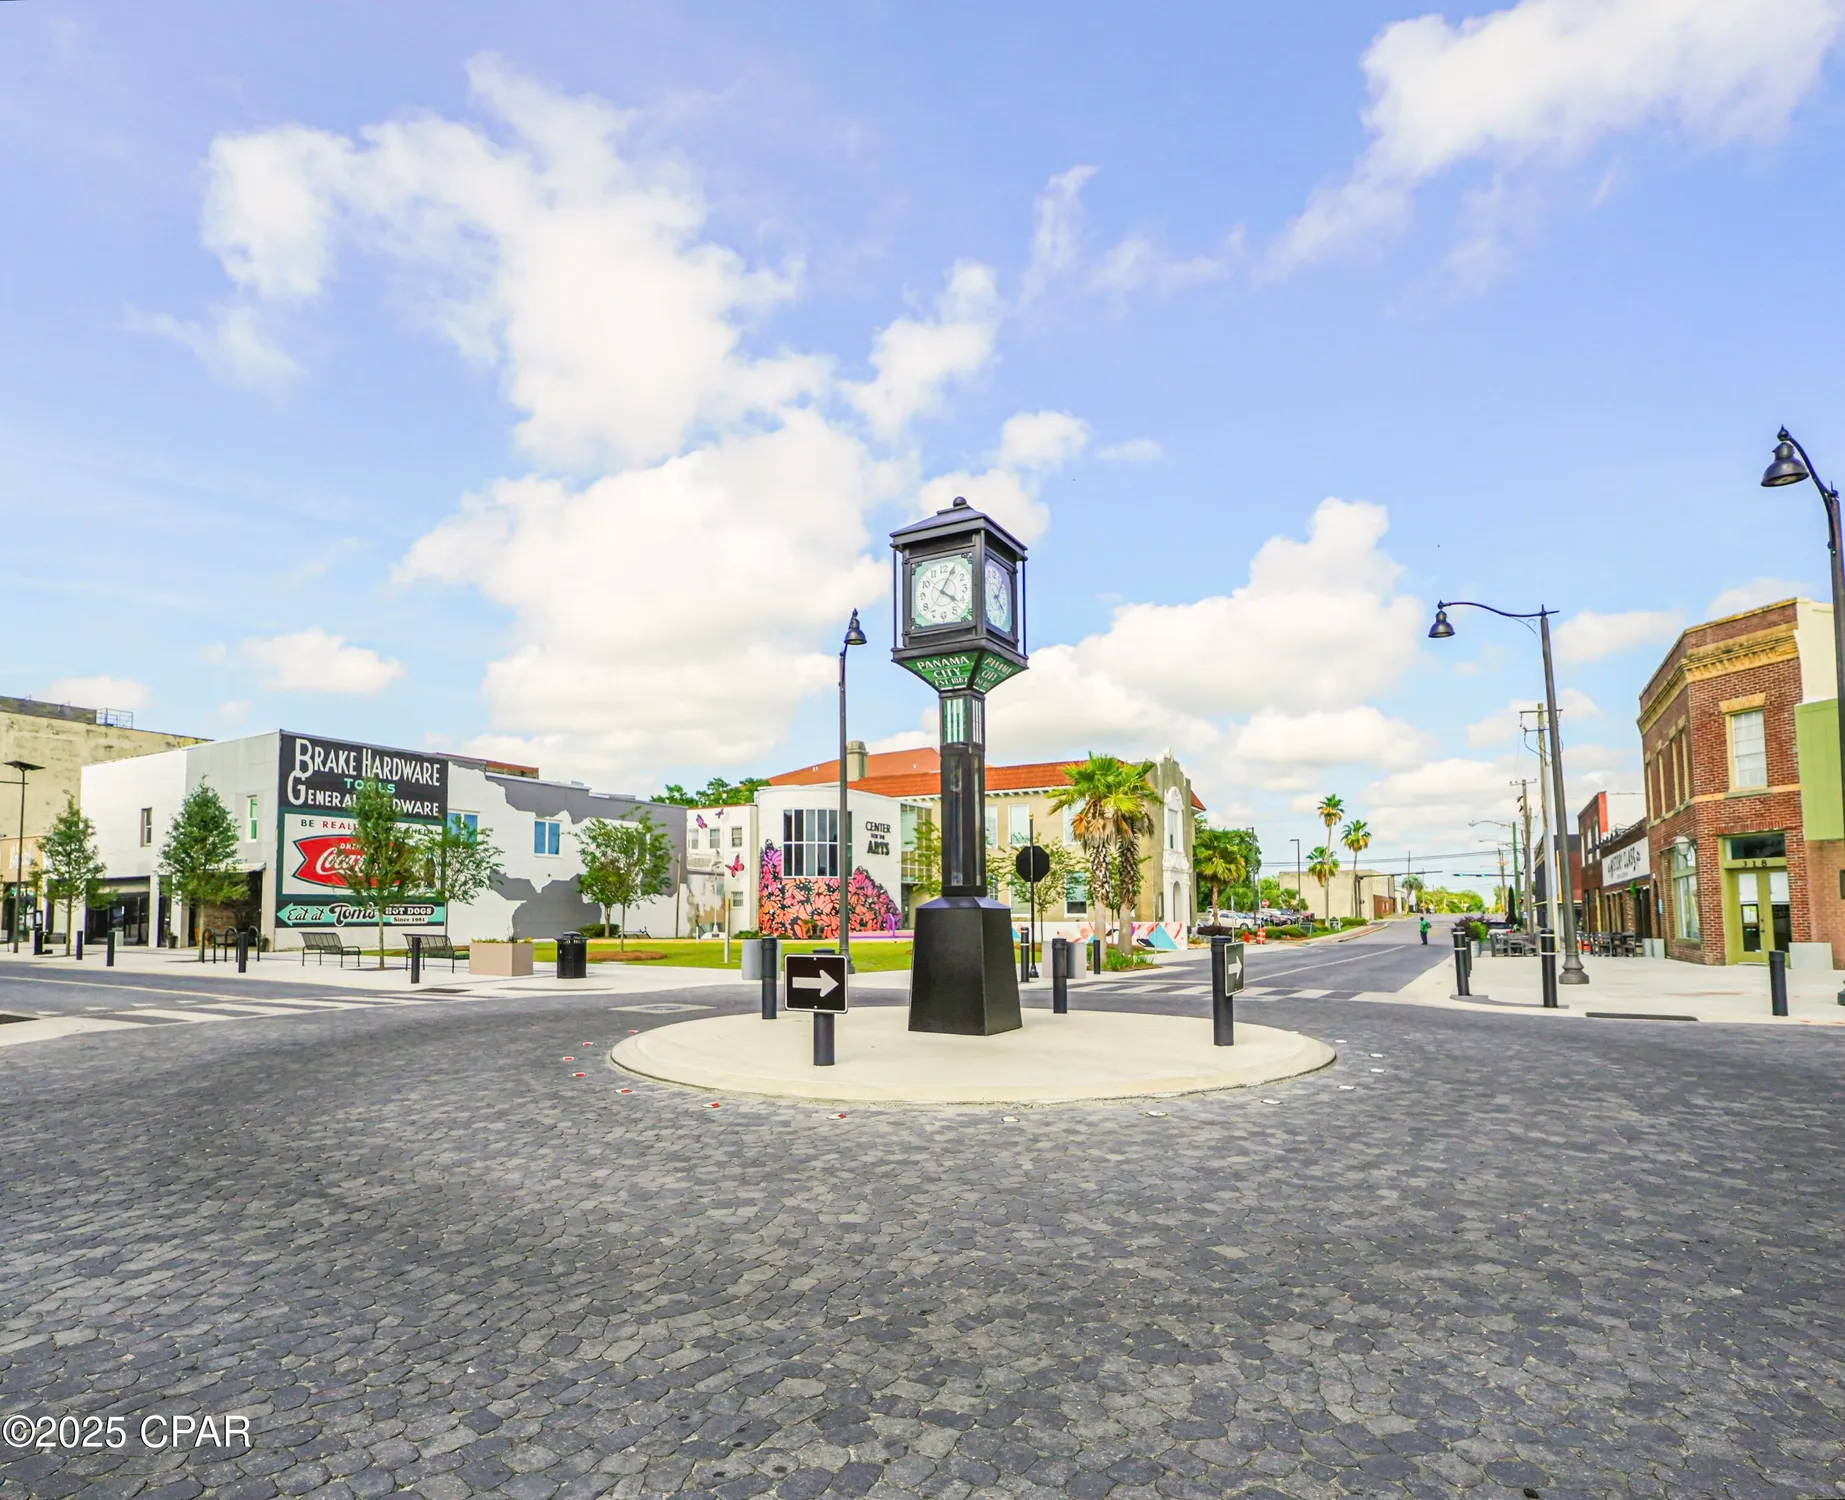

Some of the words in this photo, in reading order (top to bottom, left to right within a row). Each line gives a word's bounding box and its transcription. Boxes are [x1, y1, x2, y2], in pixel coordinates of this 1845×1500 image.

[940, 565, 948, 574] 12
[930, 570, 937, 579] 11
[960, 573, 965, 582] 2
[922, 580, 931, 589] 10
[962, 584, 968, 593] 3
[920, 592, 926, 601] 9
[923, 603, 929, 611] 8
[952, 606, 958, 616] 5
[941, 611, 947, 620] 6
[917, 656, 970, 670] PANAMA
[934, 667, 960, 678] CITY
[295, 738, 357, 778] BRAKE
[362, 748, 440, 786] HARDWARE
[344, 778, 396, 794] TOOLS
[301, 819, 314, 828] BE
[865, 821, 891, 834] CENTER
[867, 840, 890, 856] ARTS
[1743, 859, 1767, 868] 318
[287, 907, 308, 921] Eat
[311, 907, 325, 921] at
[385, 907, 405, 915] HOT
[407, 907, 432, 915] DOGS
